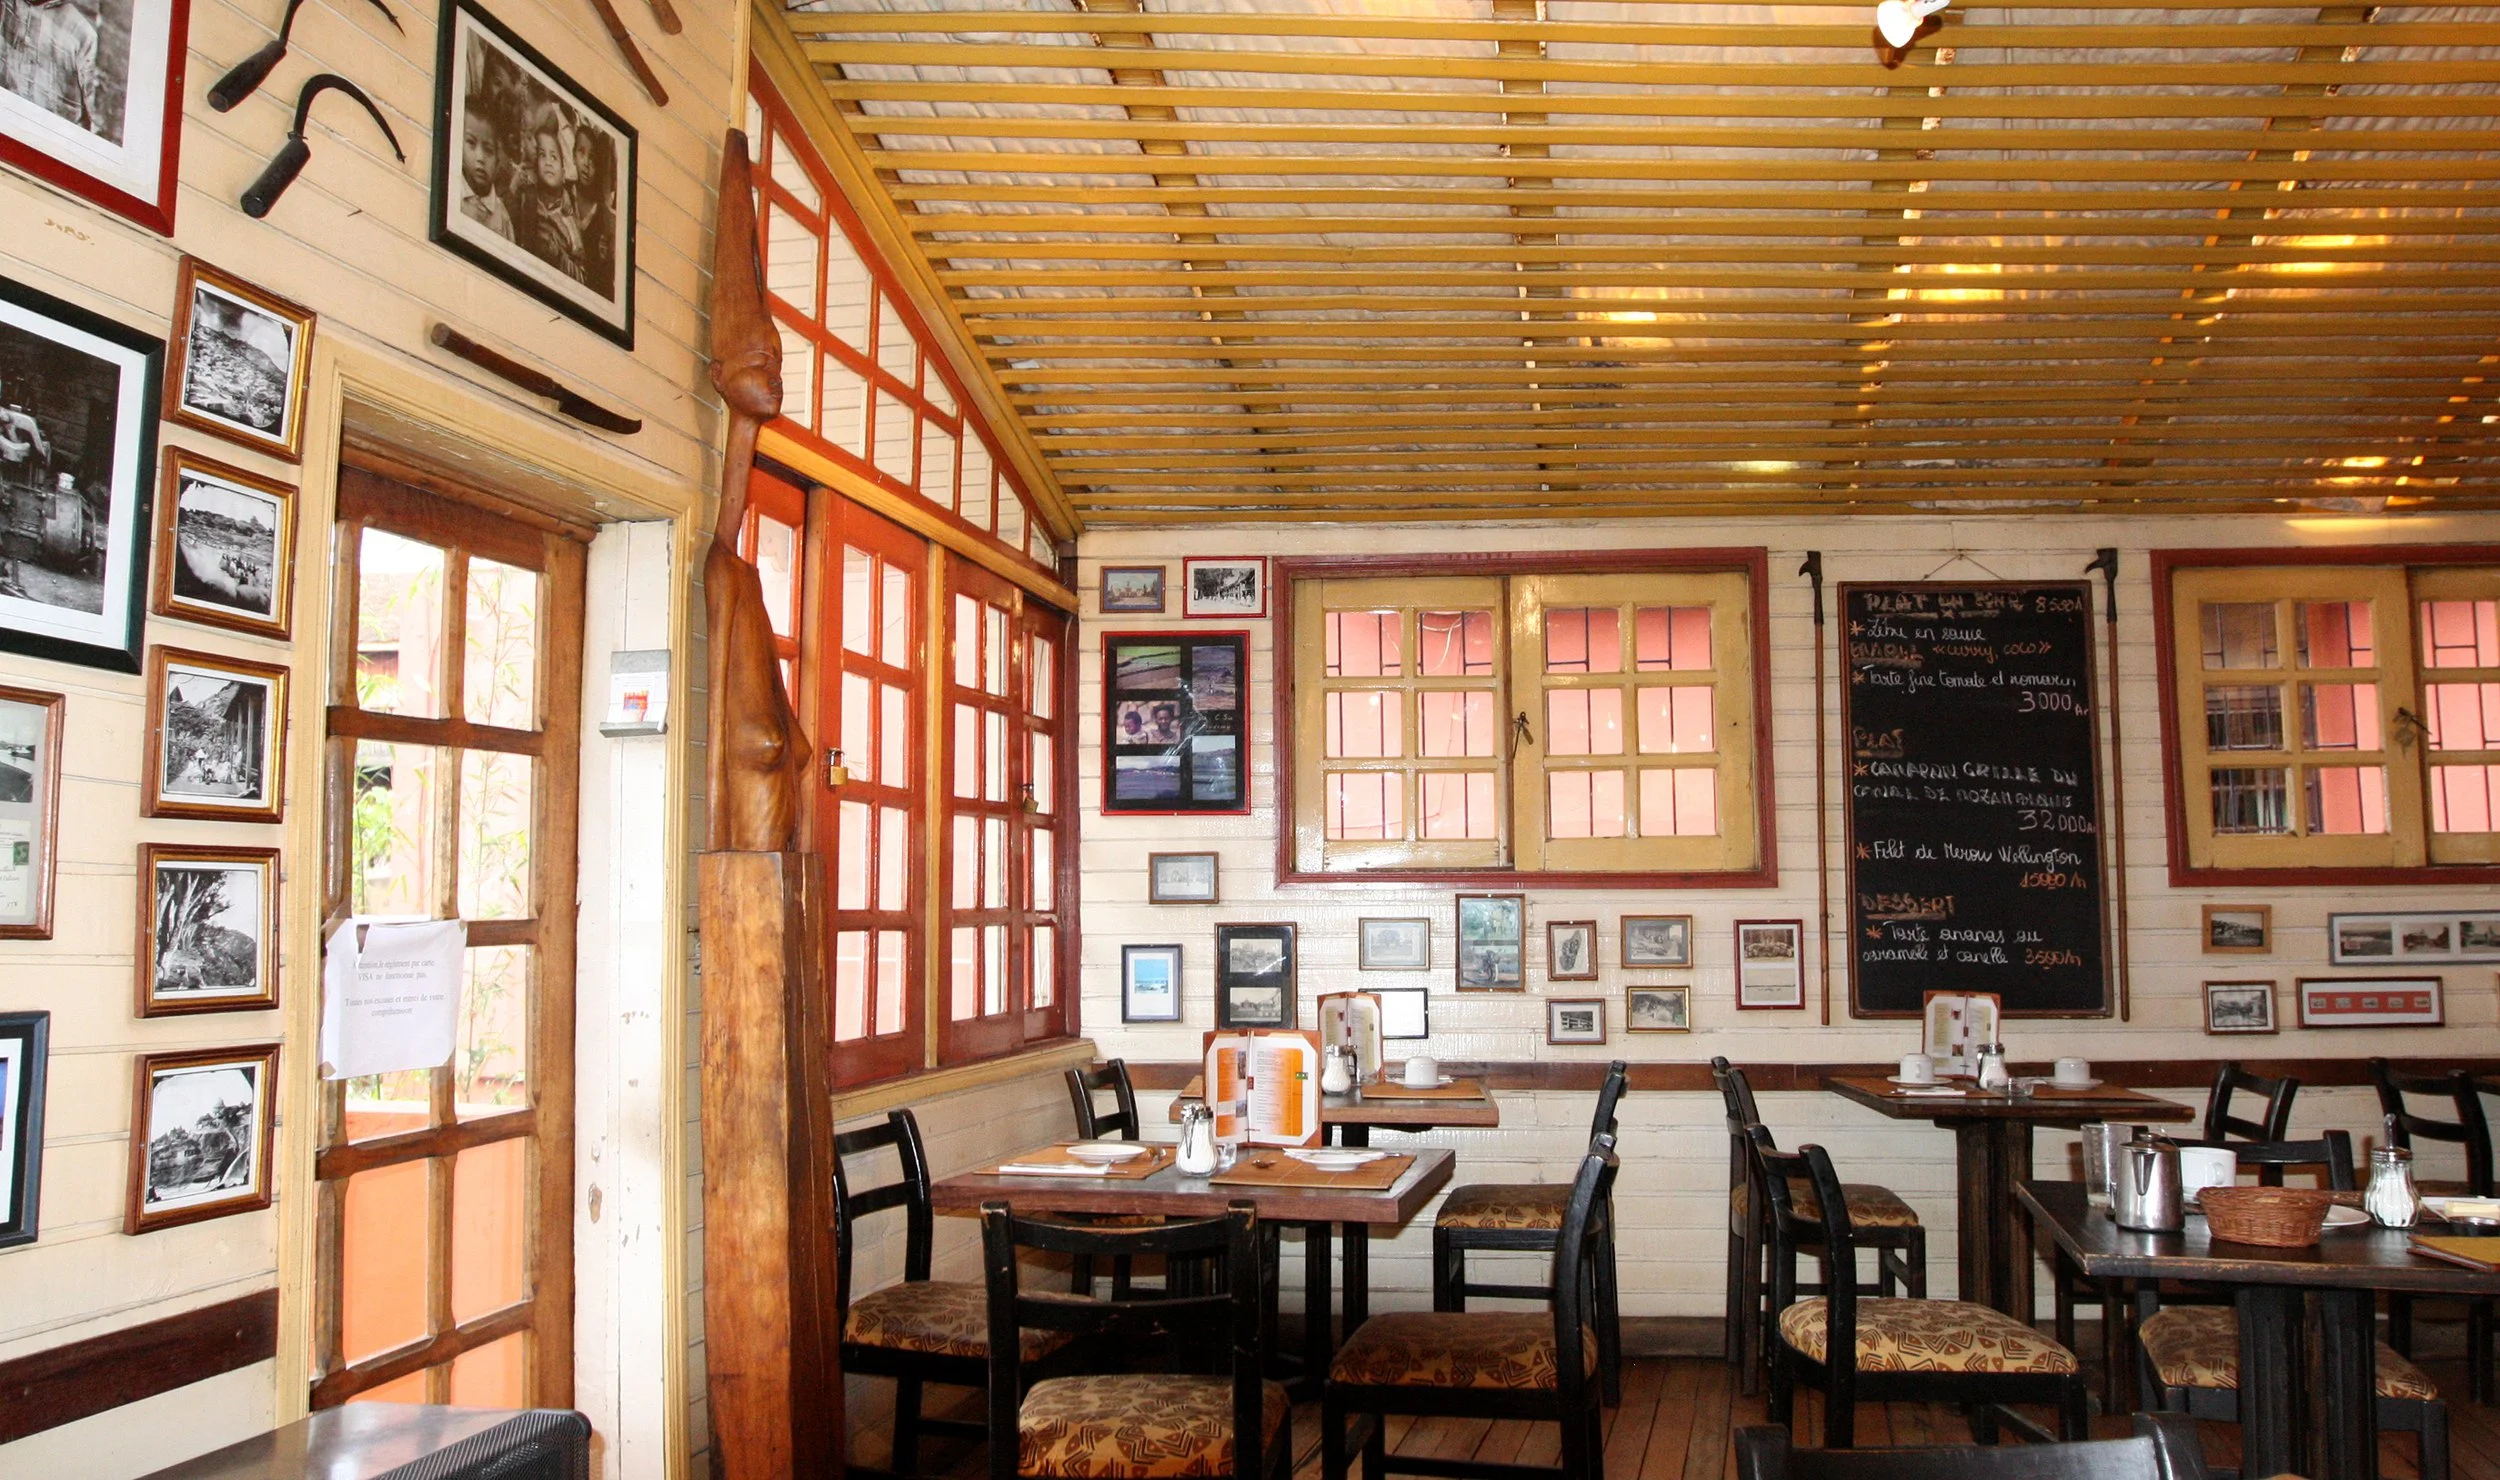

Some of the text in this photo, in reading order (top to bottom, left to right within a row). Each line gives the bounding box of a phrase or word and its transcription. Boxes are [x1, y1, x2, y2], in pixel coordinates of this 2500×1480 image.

[1915, 627, 1936, 640] en
[1942, 627, 1986, 640] sauce
[1873, 839, 1906, 859] Filet
[1915, 844, 1938, 859] de
[1998, 844, 2082, 873] Wellington
[1939, 930, 2004, 943] ananas
[1936, 943, 1948, 961] et
